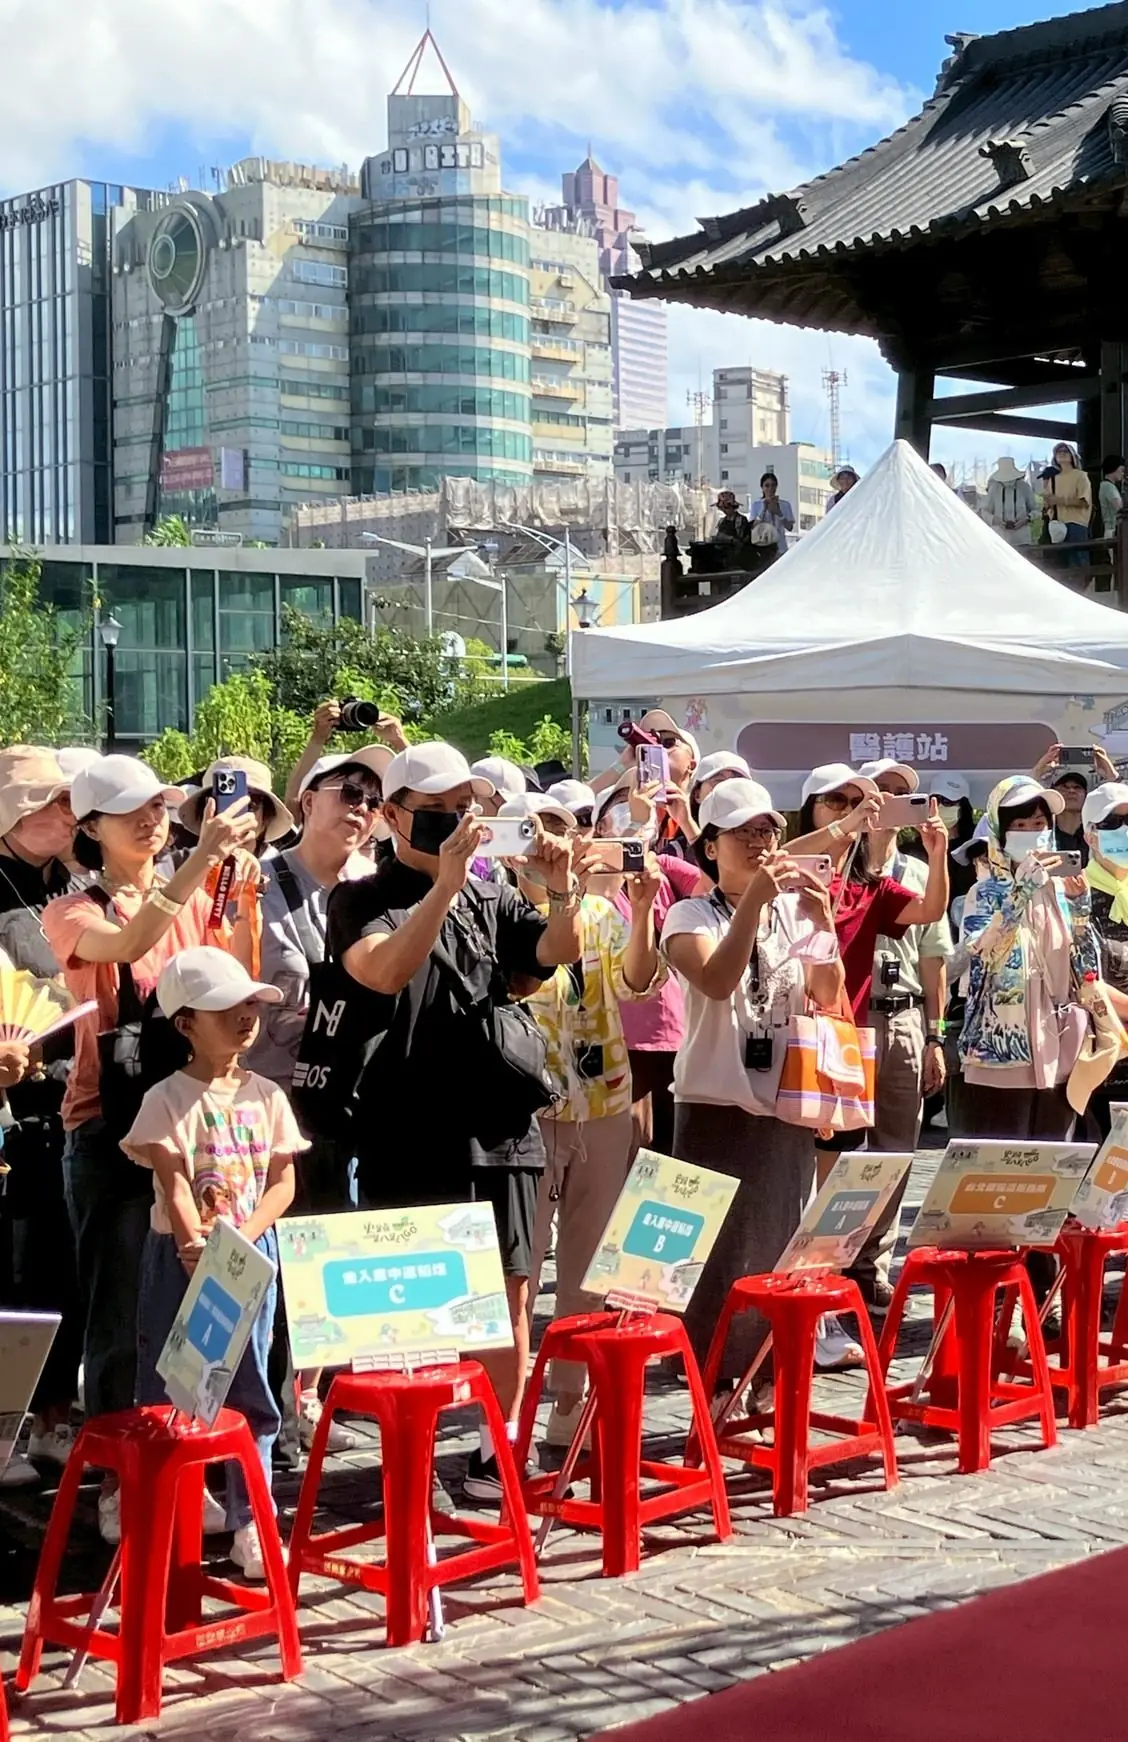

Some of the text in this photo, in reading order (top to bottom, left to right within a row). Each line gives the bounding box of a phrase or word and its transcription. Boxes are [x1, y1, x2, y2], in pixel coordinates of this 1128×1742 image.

[849, 732, 949, 762] 醫護站
[993, 1195, 1007, 1209] C
[652, 1234, 666, 1253] B
[388, 1283, 406, 1305] C
